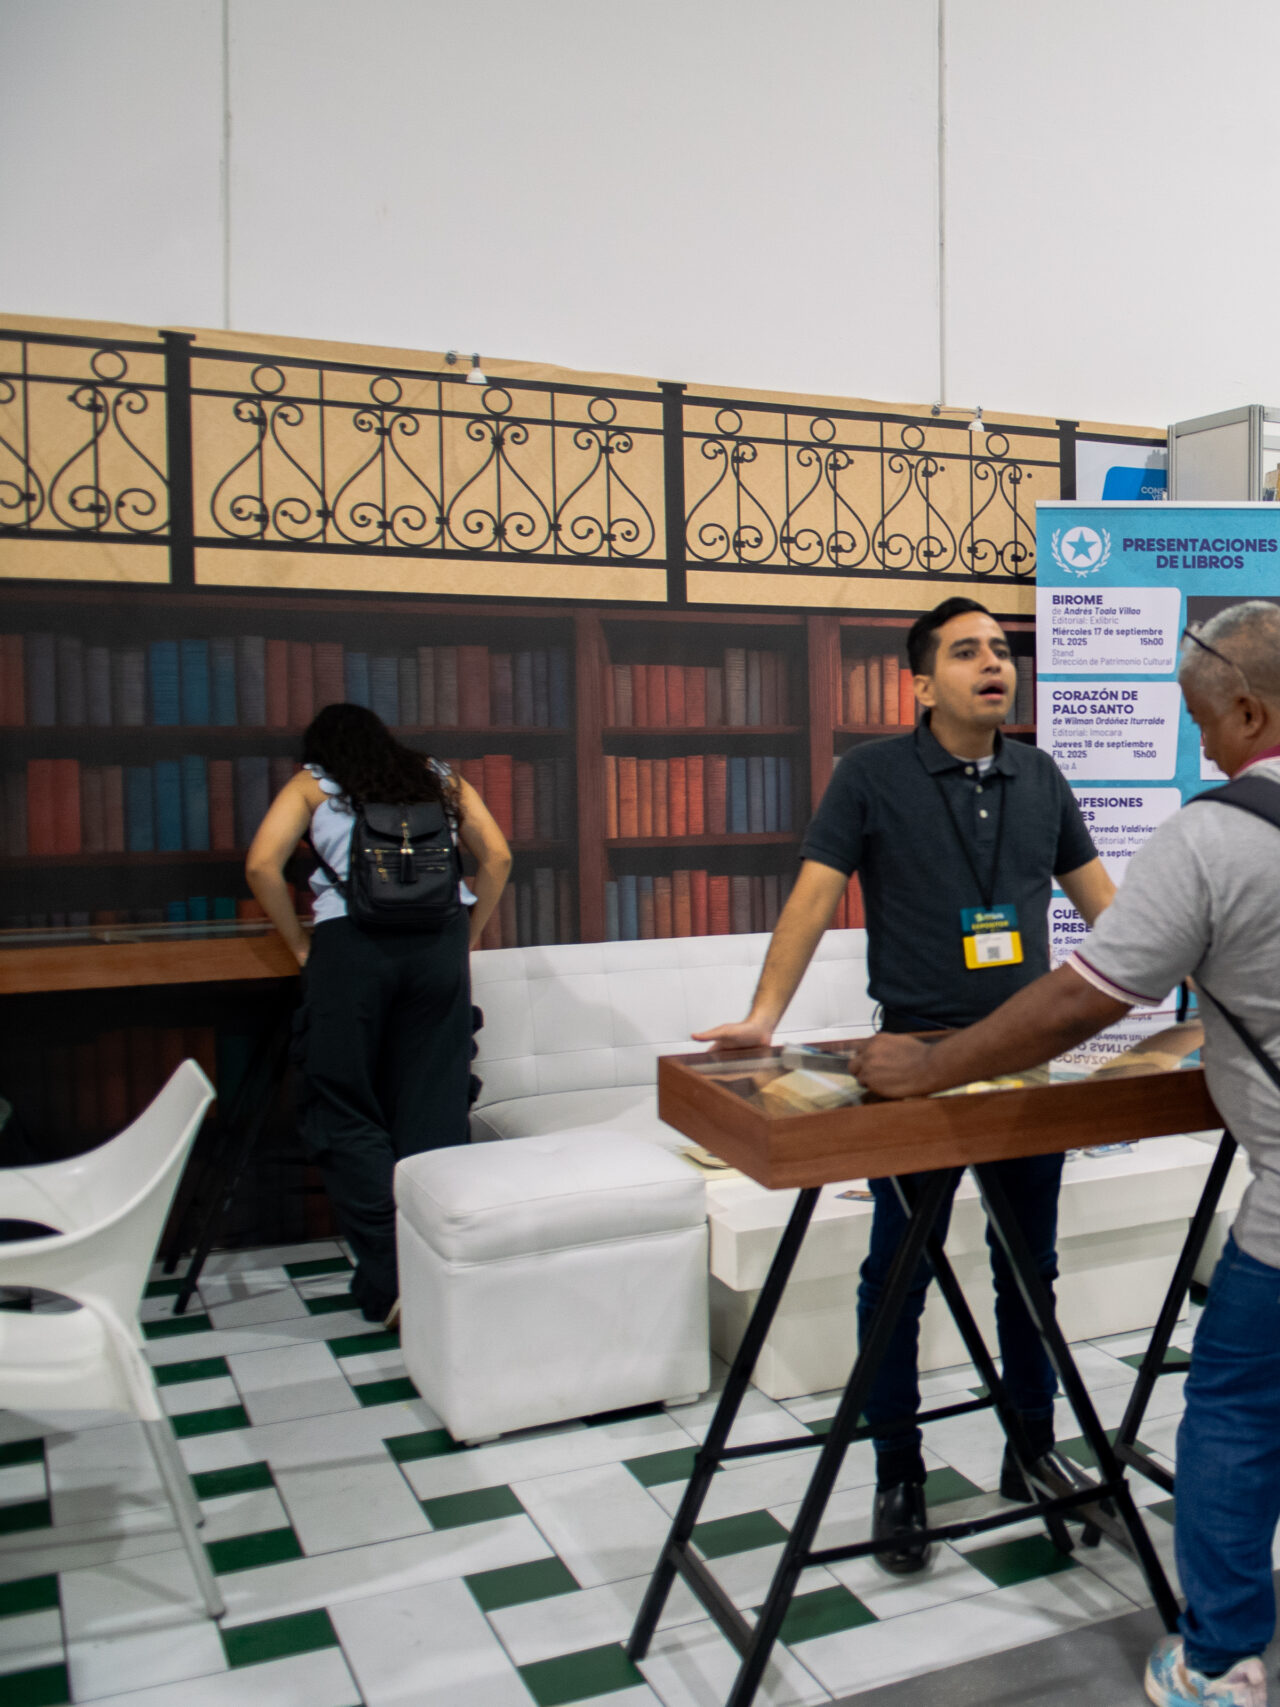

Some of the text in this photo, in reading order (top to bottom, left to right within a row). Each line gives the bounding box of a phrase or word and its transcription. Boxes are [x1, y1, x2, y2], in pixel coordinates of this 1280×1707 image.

[1122, 538, 1278, 553] PRESENTACIONES
[1156, 555, 1245, 569] DE LIBROS
[1052, 594, 1103, 605] BIROME
[1052, 607, 1062, 615] de
[1094, 627, 1102, 635] 17
[1104, 627, 1114, 635] de
[1116, 627, 1163, 637] septiembre
[1052, 638, 1088, 646] FIL 2025
[1140, 638, 1164, 646] 15h00
[1052, 649, 1074, 657] Stand
[1089, 658, 1099, 666] de
[1052, 688, 1138, 701] CORAZÓN DE
[1052, 704, 1134, 714] PALO SANTO
[1052, 717, 1062, 725] de
[1052, 740, 1154, 750] Jueves 18 de septiembre
[1067, 750, 1088, 759] 2025
[1133, 750, 1157, 759] 15h00
